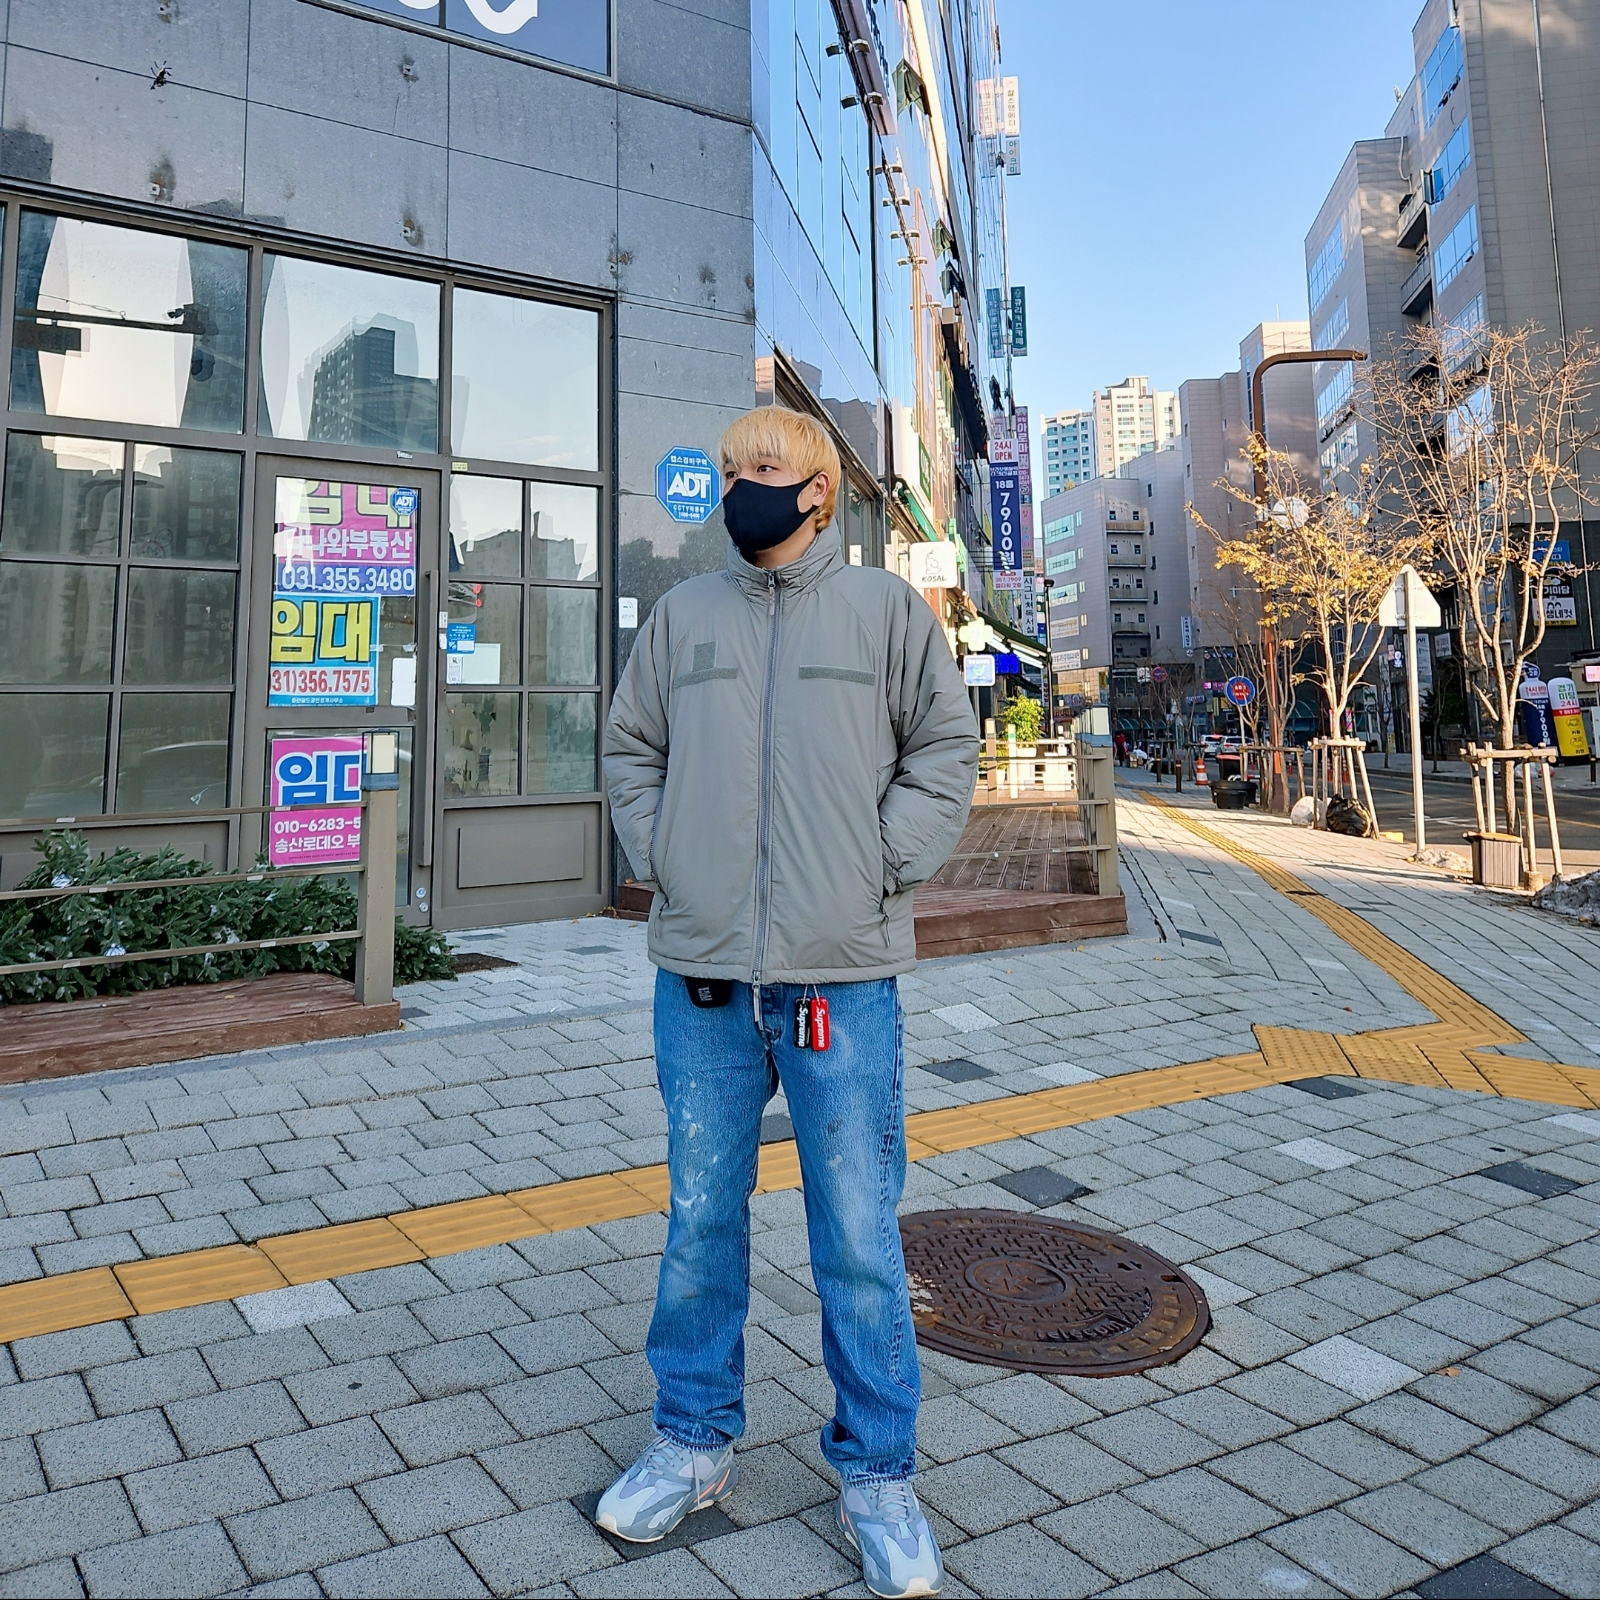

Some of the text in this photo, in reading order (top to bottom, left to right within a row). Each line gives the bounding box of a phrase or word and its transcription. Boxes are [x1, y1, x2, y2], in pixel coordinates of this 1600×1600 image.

[994, 441, 1012, 450] 24시
[1016, 423, 1029, 453] 아로마
[994, 451, 1013, 461] OPEN
[667, 471, 711, 499] ADT
[395, 495, 414, 507] ADT
[921, 575, 948, 583] KOSAL
[1541, 585, 1570, 595] 기미당
[1023, 576, 1035, 634] 시그니처독서실
[271, 599, 373, 664] 임대
[268, 669, 371, 694] 31)356.7575
[275, 835, 344, 854] 송산로데오
[796, 1006, 809, 1048] Supreme
[814, 1007, 826, 1048] Supreme
